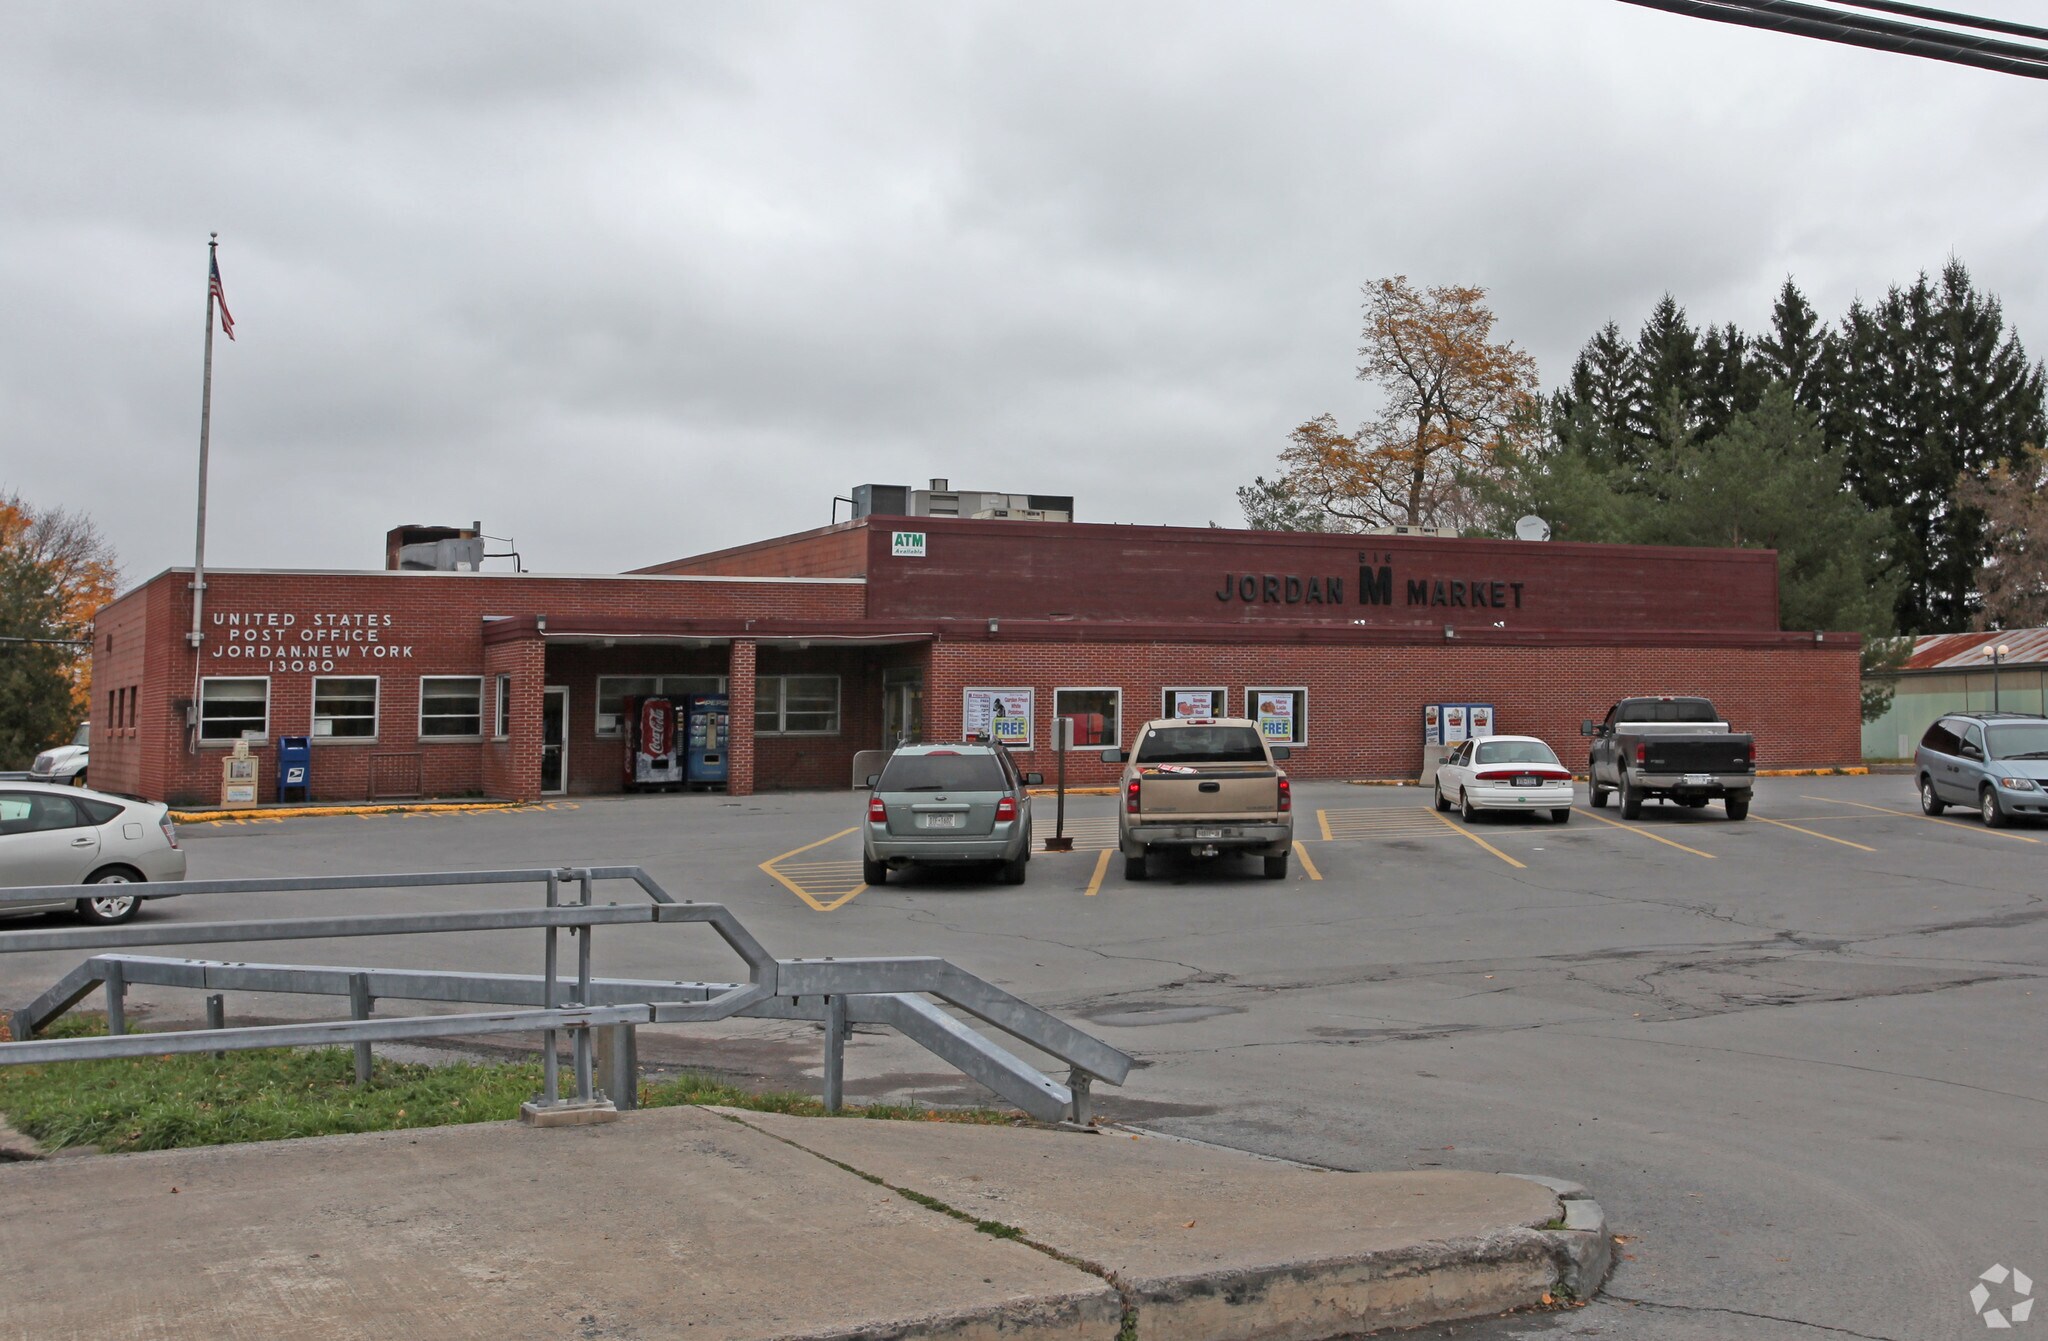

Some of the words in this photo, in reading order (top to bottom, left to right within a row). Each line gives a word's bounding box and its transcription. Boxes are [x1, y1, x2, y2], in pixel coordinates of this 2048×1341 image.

[895, 533, 923, 547] ATM
[1358, 551, 1392, 563] BIG
[1216, 573, 1344, 605] JORDAN
[1358, 565, 1393, 605] M
[1407, 579, 1525, 608] MARKET
[213, 613, 295, 626] UNITED
[313, 614, 392, 626] STATES
[229, 629, 286, 642] POST
[300, 629, 379, 642] OFFICE
[359, 645, 413, 658] YORK
[269, 660, 334, 672] 13080
[995, 722, 1025, 735] FREE
[1263, 722, 1288, 735] FREE
